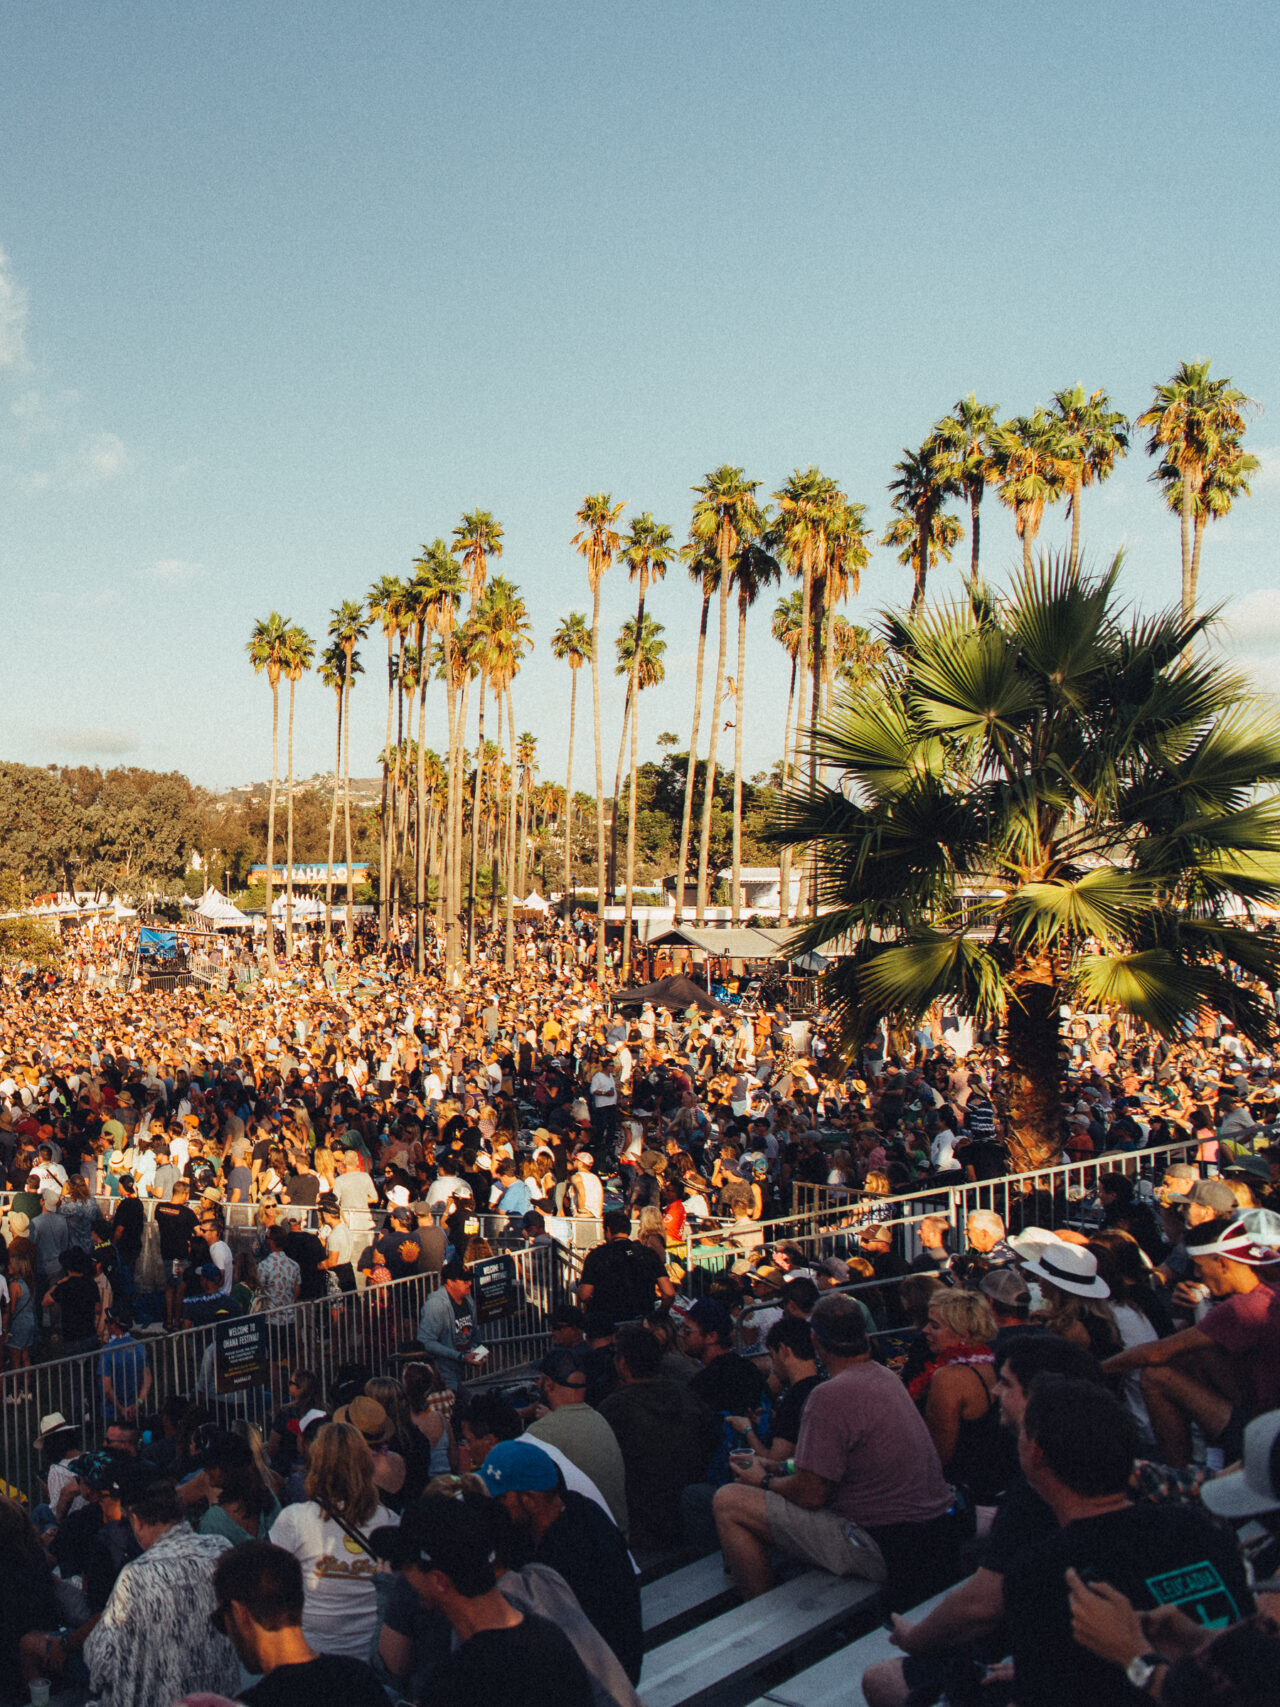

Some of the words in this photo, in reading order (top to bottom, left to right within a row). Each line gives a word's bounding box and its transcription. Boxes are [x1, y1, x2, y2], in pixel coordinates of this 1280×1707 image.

[228, 1324, 249, 1337] WELCOME
[249, 1322, 256, 1332] TO
[223, 1337, 238, 1349] OHANA
[239, 1331, 260, 1346] FESTIVAL!
[1155, 1569, 1216, 1600] LEUCADIA
